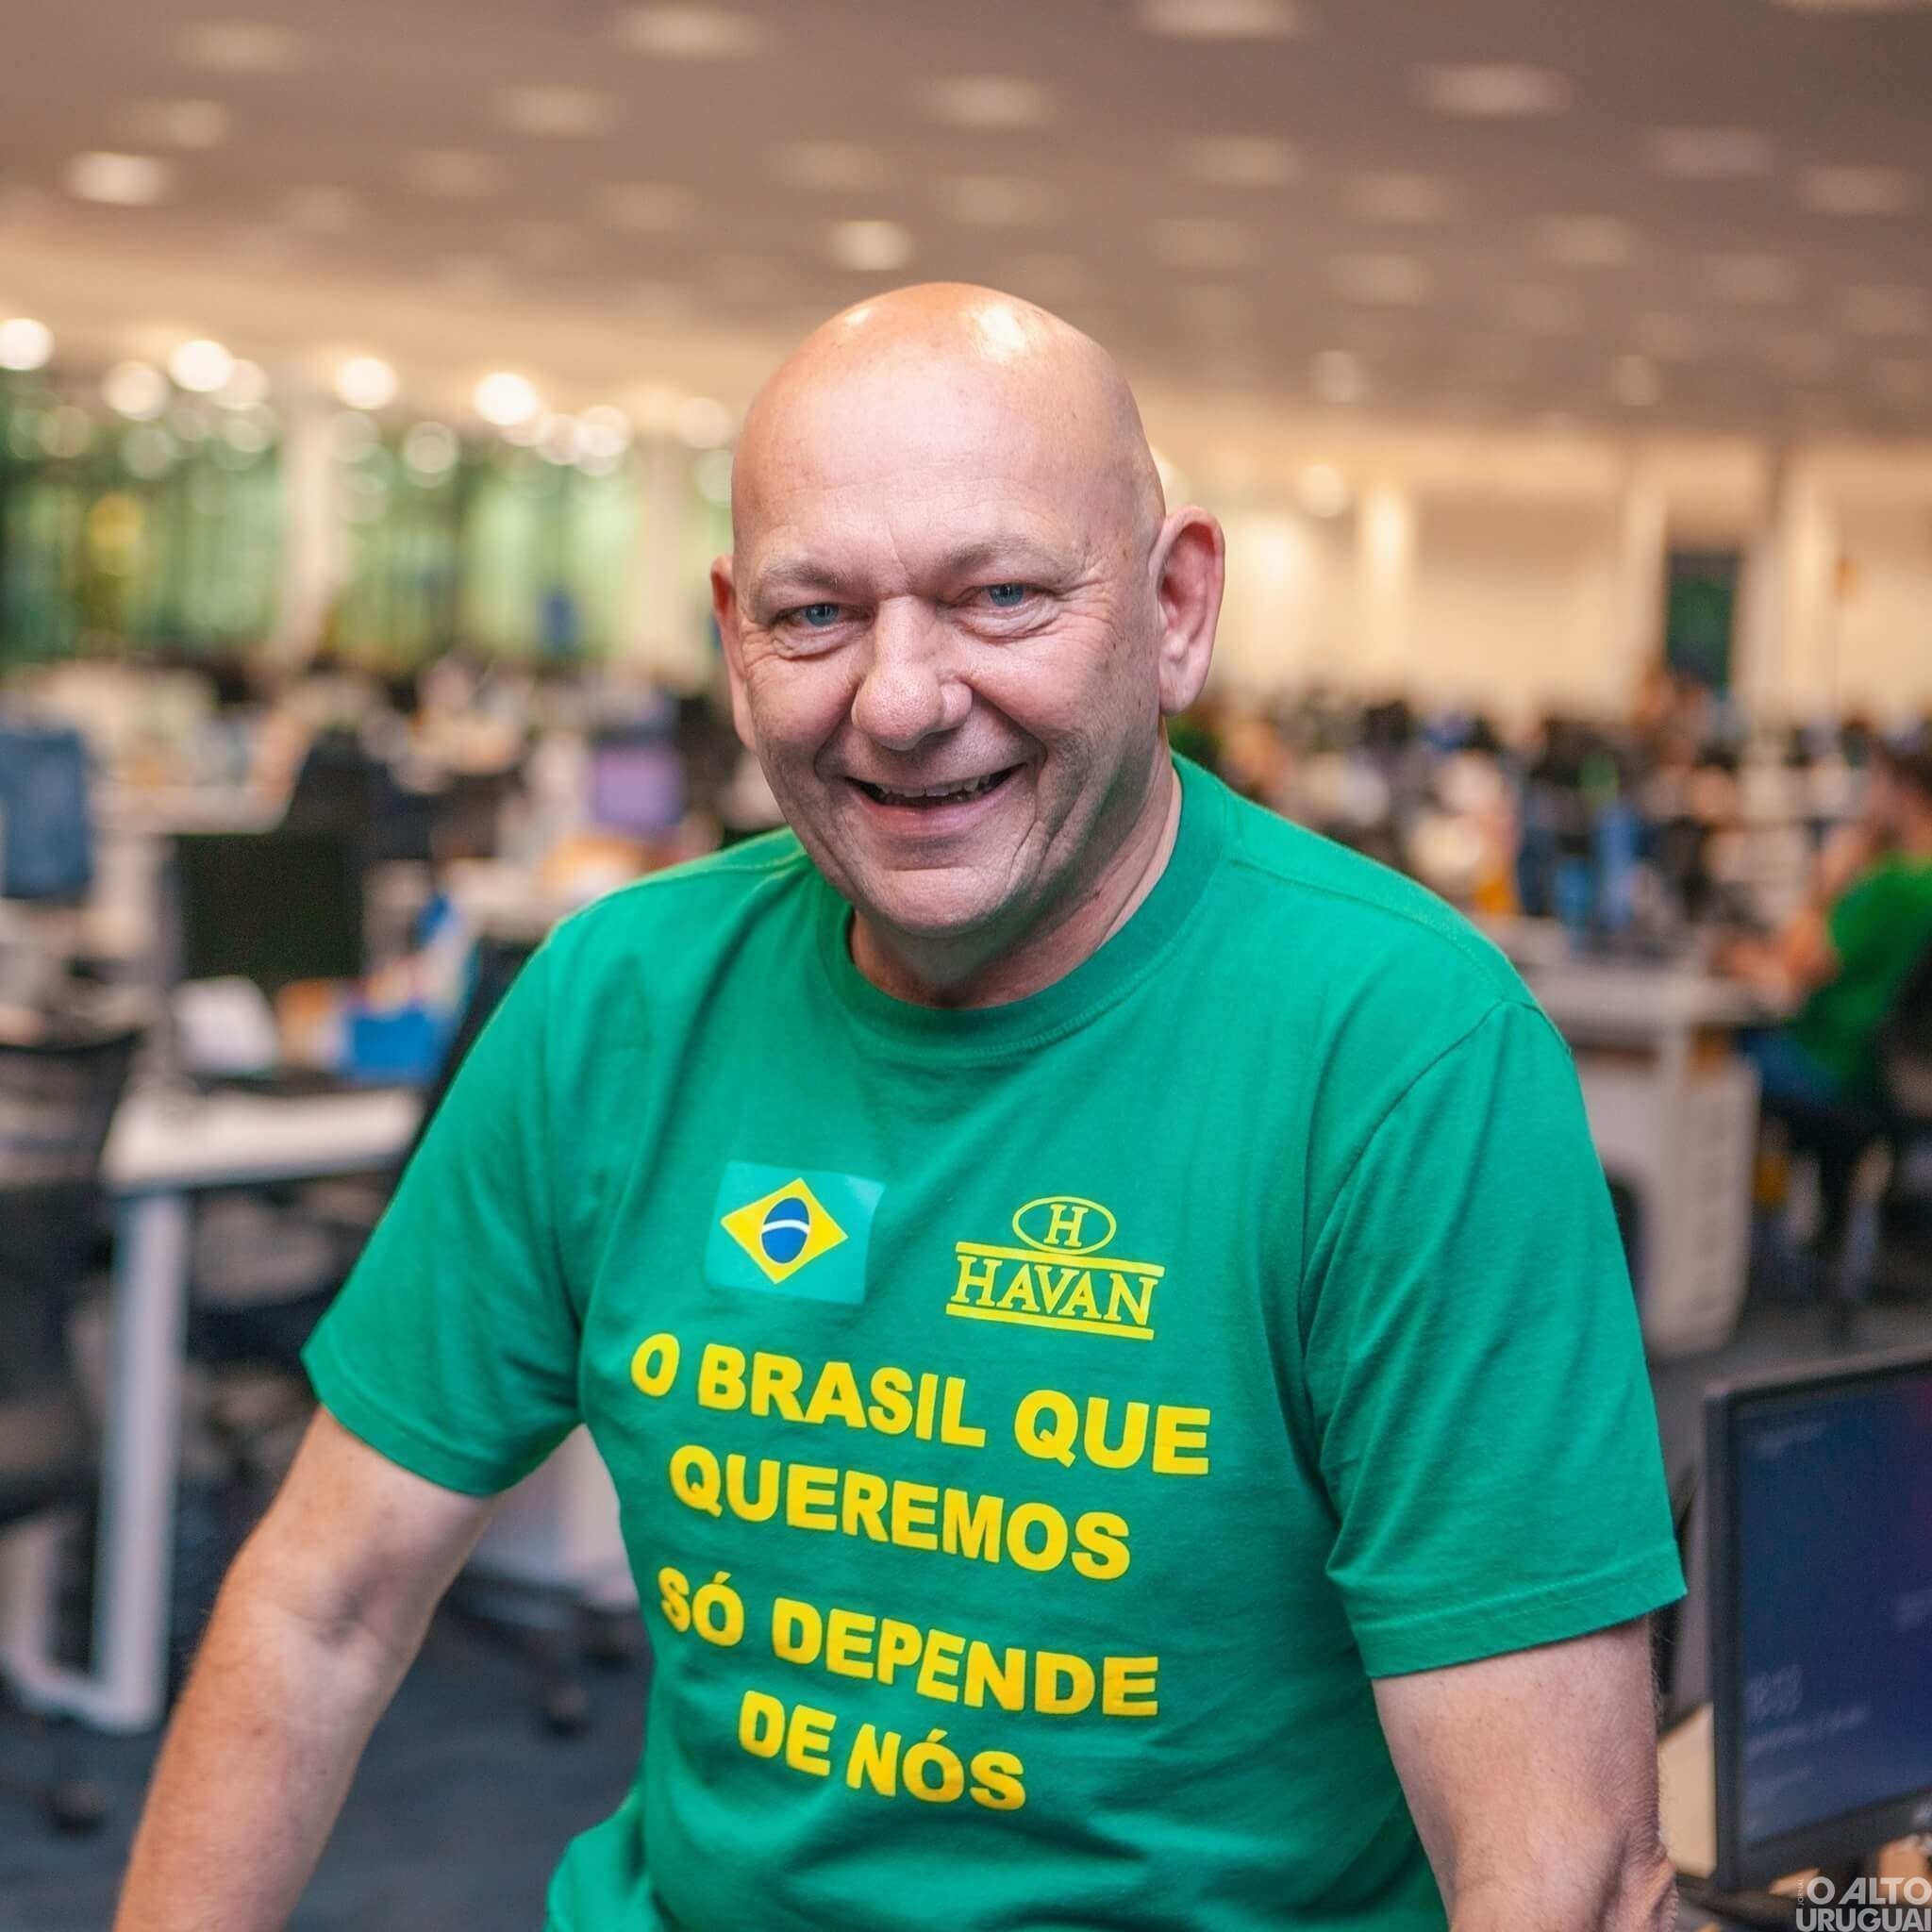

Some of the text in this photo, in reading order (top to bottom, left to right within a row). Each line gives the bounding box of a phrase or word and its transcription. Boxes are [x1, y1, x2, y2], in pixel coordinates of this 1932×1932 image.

[951, 1255, 1158, 1326] HAVAN
[1043, 1204, 1089, 1247] H
[630, 1333, 1211, 1475] O BRASIL QUE
[669, 1443, 1131, 1581] QUEREMOS
[658, 1566, 1159, 1717] SÓ DEPENDE
[738, 1689, 1026, 1811] DE NÓS
